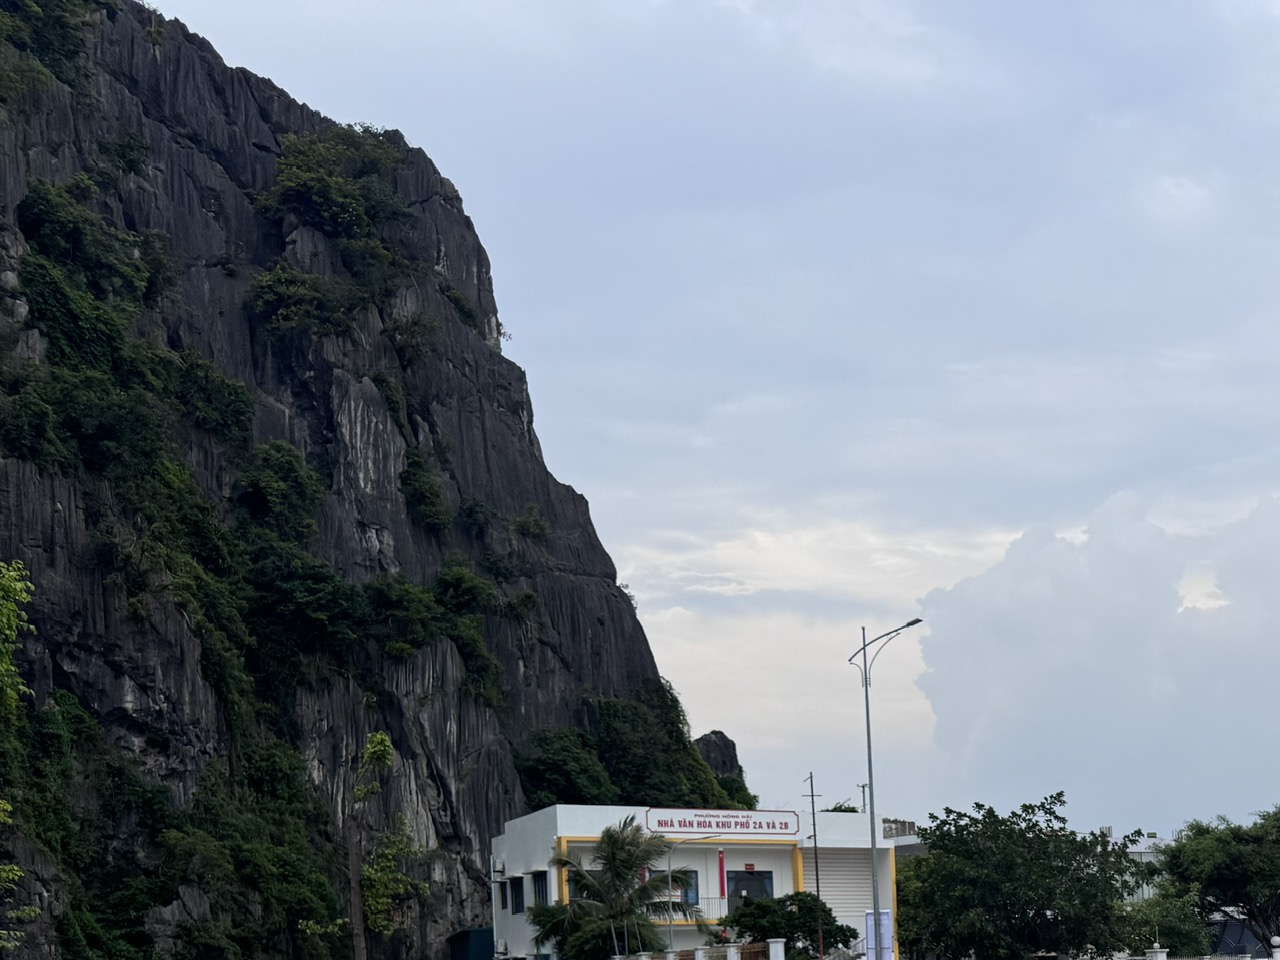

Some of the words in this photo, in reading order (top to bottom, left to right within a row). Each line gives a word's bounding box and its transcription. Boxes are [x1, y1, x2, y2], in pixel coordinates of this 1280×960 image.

[657, 818, 675, 828] NHÀ
[678, 818, 694, 828] VĂN
[697, 819, 713, 829] HÓA
[715, 820, 732, 829] KHU
[734, 819, 751, 830] PHỐ
[753, 821, 763, 830] 2A
[766, 820, 777, 830] VÀ
[779, 821, 789, 830] 2B
